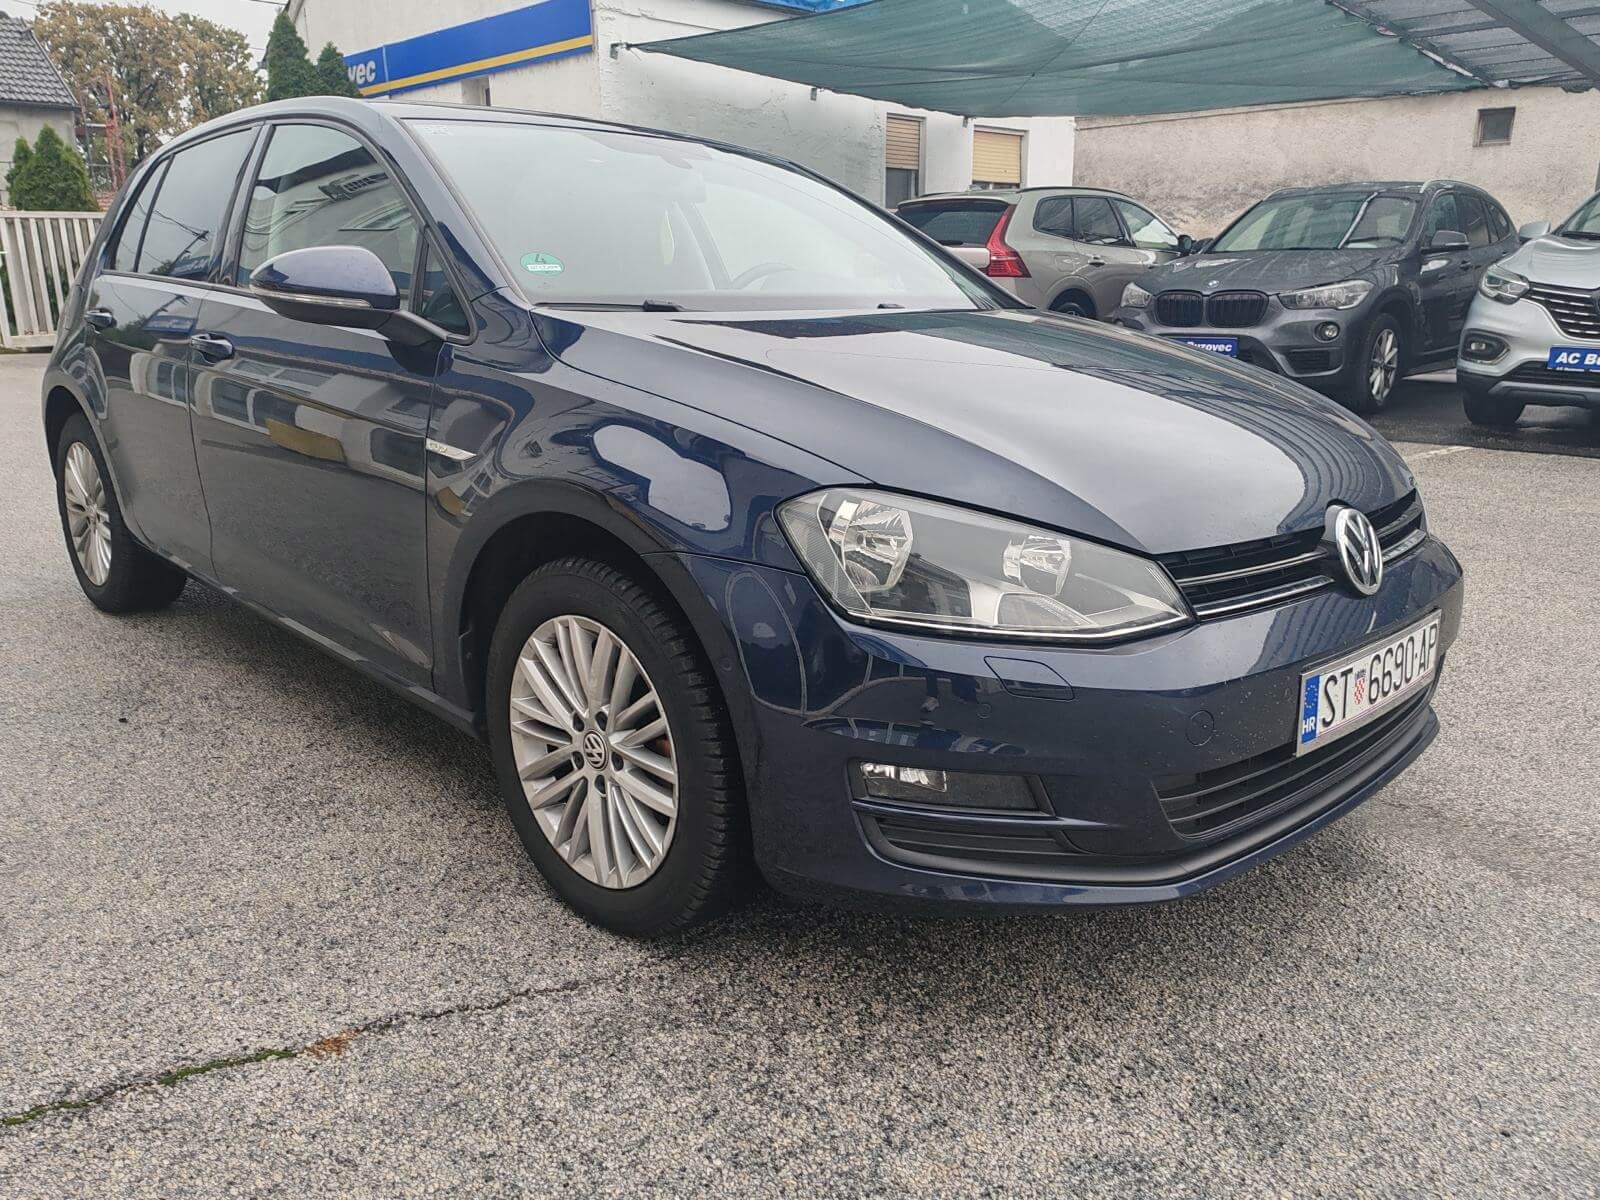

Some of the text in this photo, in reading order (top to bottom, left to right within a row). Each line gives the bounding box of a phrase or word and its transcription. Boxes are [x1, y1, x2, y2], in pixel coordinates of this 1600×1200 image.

[1555, 352, 1600, 366] AC B
[1322, 667, 1354, 728] ST
[1301, 715, 1316, 734] HR
